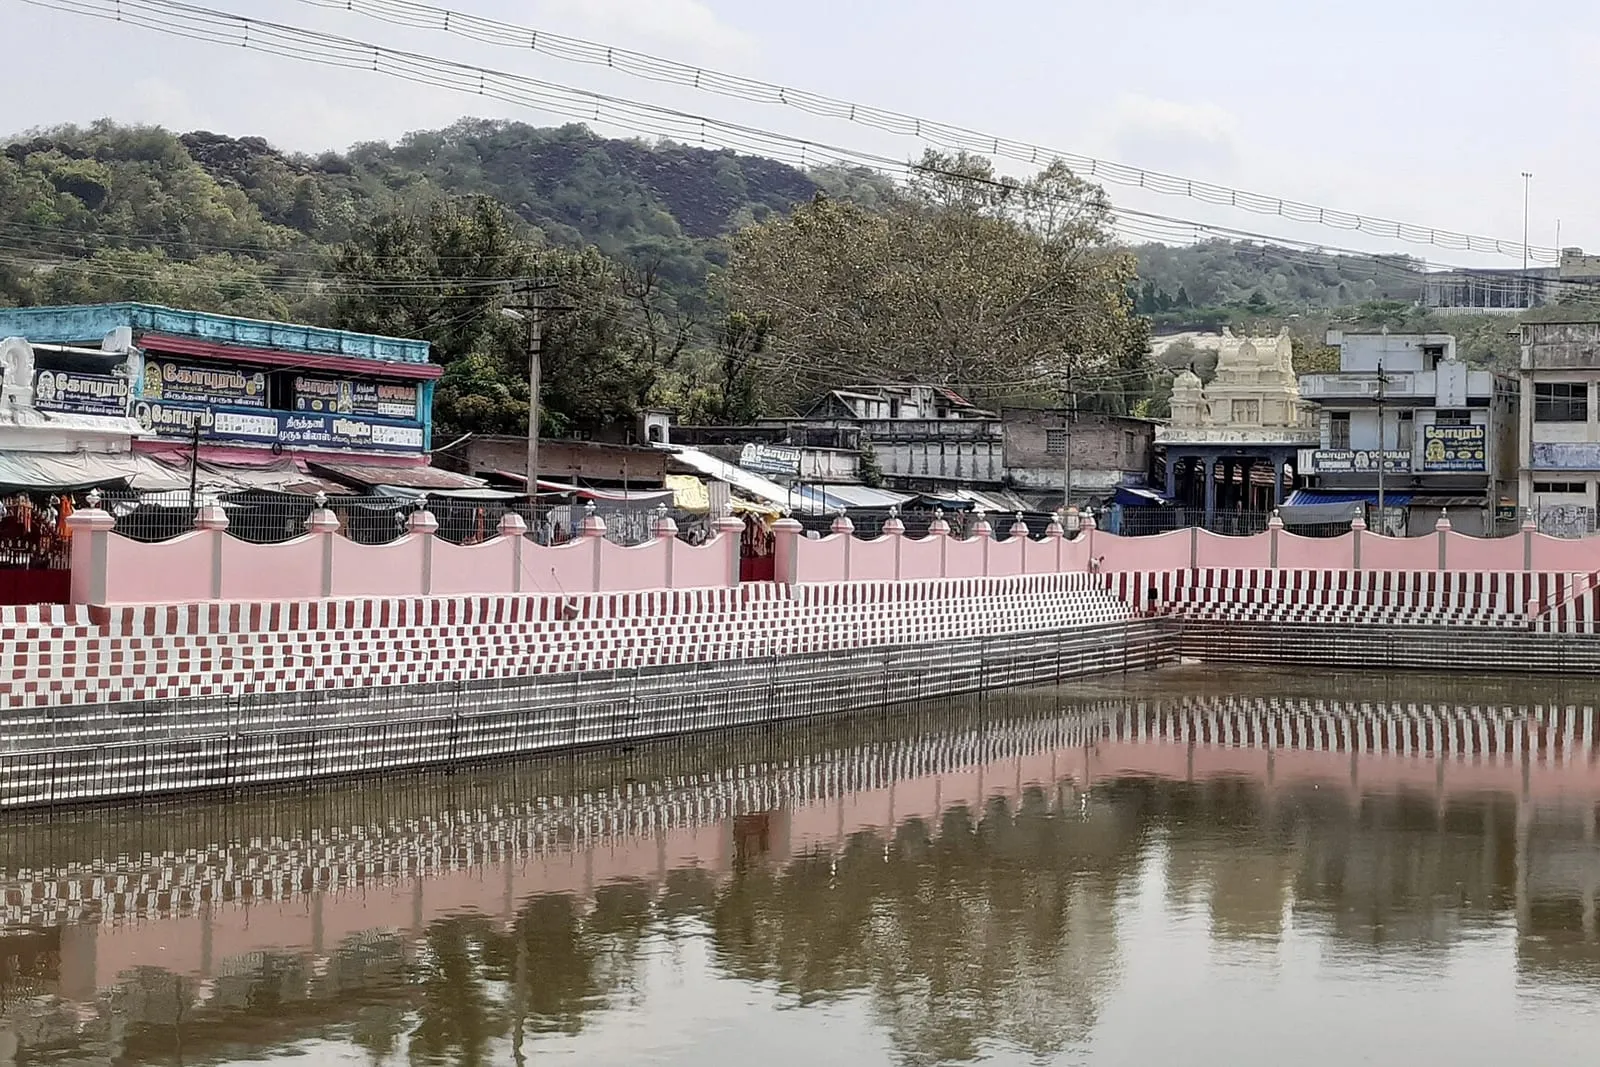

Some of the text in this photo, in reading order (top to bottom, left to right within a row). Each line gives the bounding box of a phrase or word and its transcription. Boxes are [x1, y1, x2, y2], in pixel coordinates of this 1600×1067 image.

[162, 363, 246, 389] கோபுரம்
[56, 373, 127, 398] கோபுரம்
[296, 376, 338, 396] கோபுரம்
[164, 392, 208, 402] திருத்தணி
[209, 396, 233, 404] முருக
[152, 404, 214, 428] கோபுரம்
[286, 416, 325, 430] திருத்தணி
[279, 430, 301, 441] முருக
[302, 429, 332, 442] விலாஸ்
[1426, 425, 1484, 440] கோபுரம்
[756, 445, 801, 461] கோபுரம்
[1315, 450, 1355, 460] கோபுரம்
